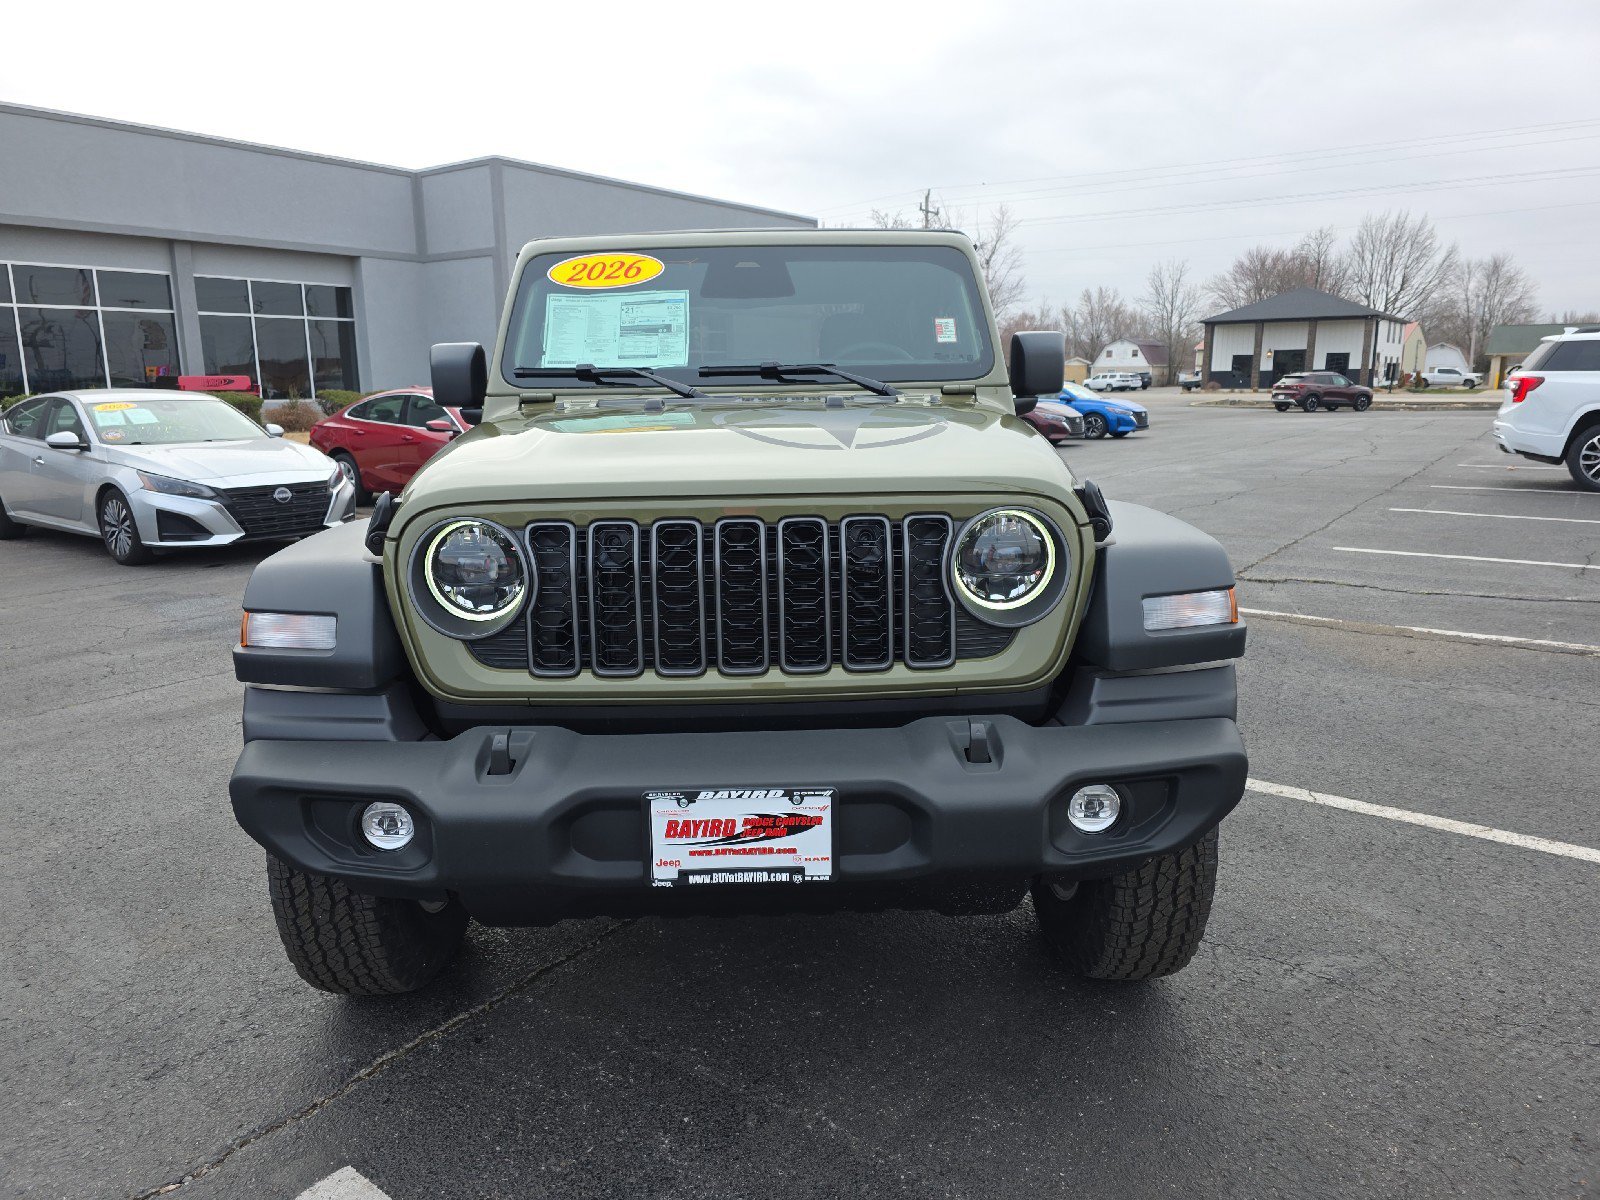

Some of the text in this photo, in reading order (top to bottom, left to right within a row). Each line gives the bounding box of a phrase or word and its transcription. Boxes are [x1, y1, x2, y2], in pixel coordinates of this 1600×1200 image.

[566, 259, 646, 282] 2026
[697, 789, 785, 800] BAYIRD
[742, 815, 823, 827] DODGE CHRYSLER
[665, 818, 737, 838] BAYIRD
[740, 827, 788, 838] JEEP RAM
[656, 859, 681, 867] Jeep
[651, 880, 674, 888] Jeep
